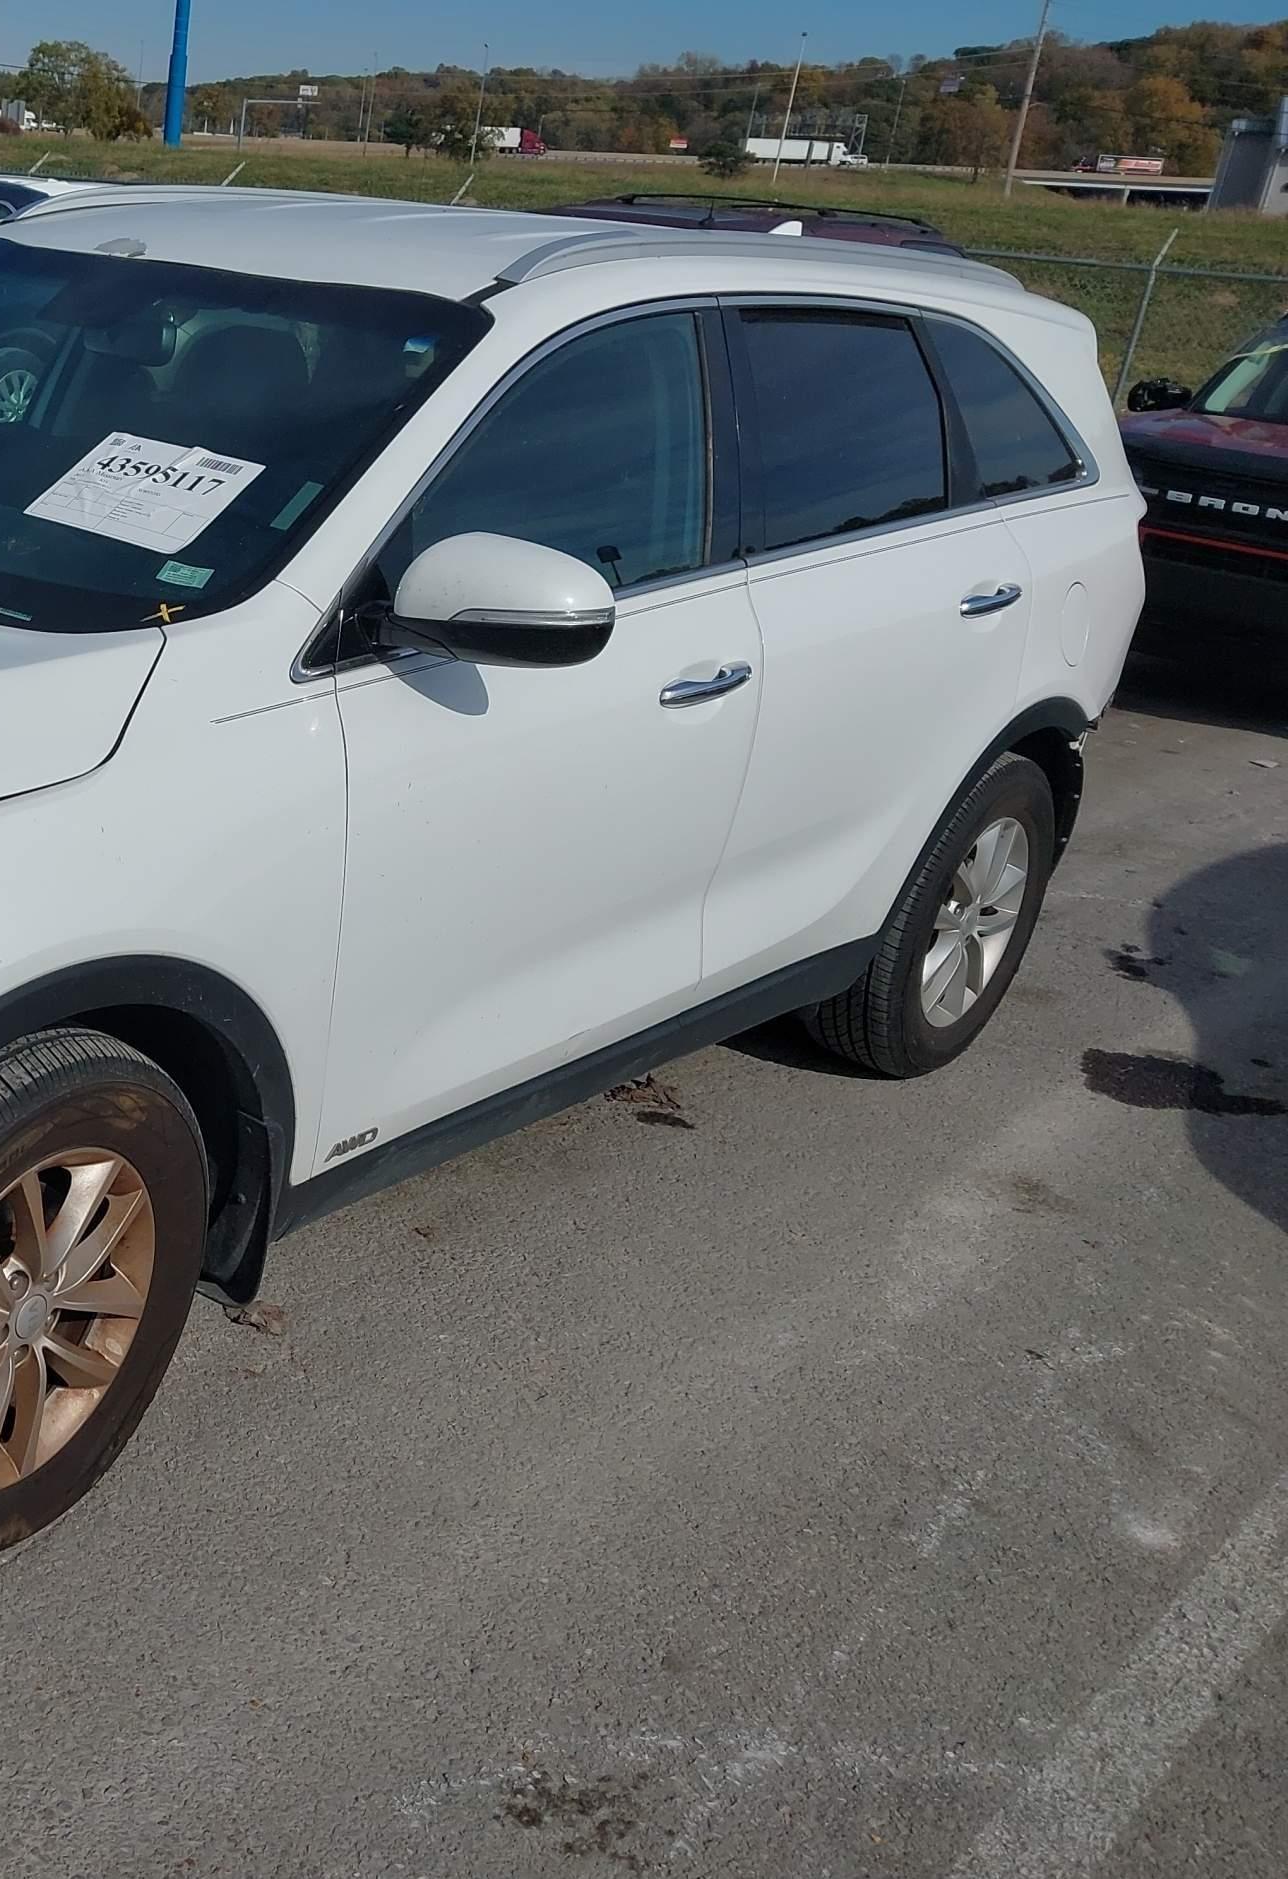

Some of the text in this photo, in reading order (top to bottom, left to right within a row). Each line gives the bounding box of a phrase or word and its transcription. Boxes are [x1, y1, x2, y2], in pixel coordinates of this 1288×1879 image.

[95, 455, 226, 495] 43595117
[1166, 490, 1288, 521] BRON
[324, 1127, 378, 1162] AWD
